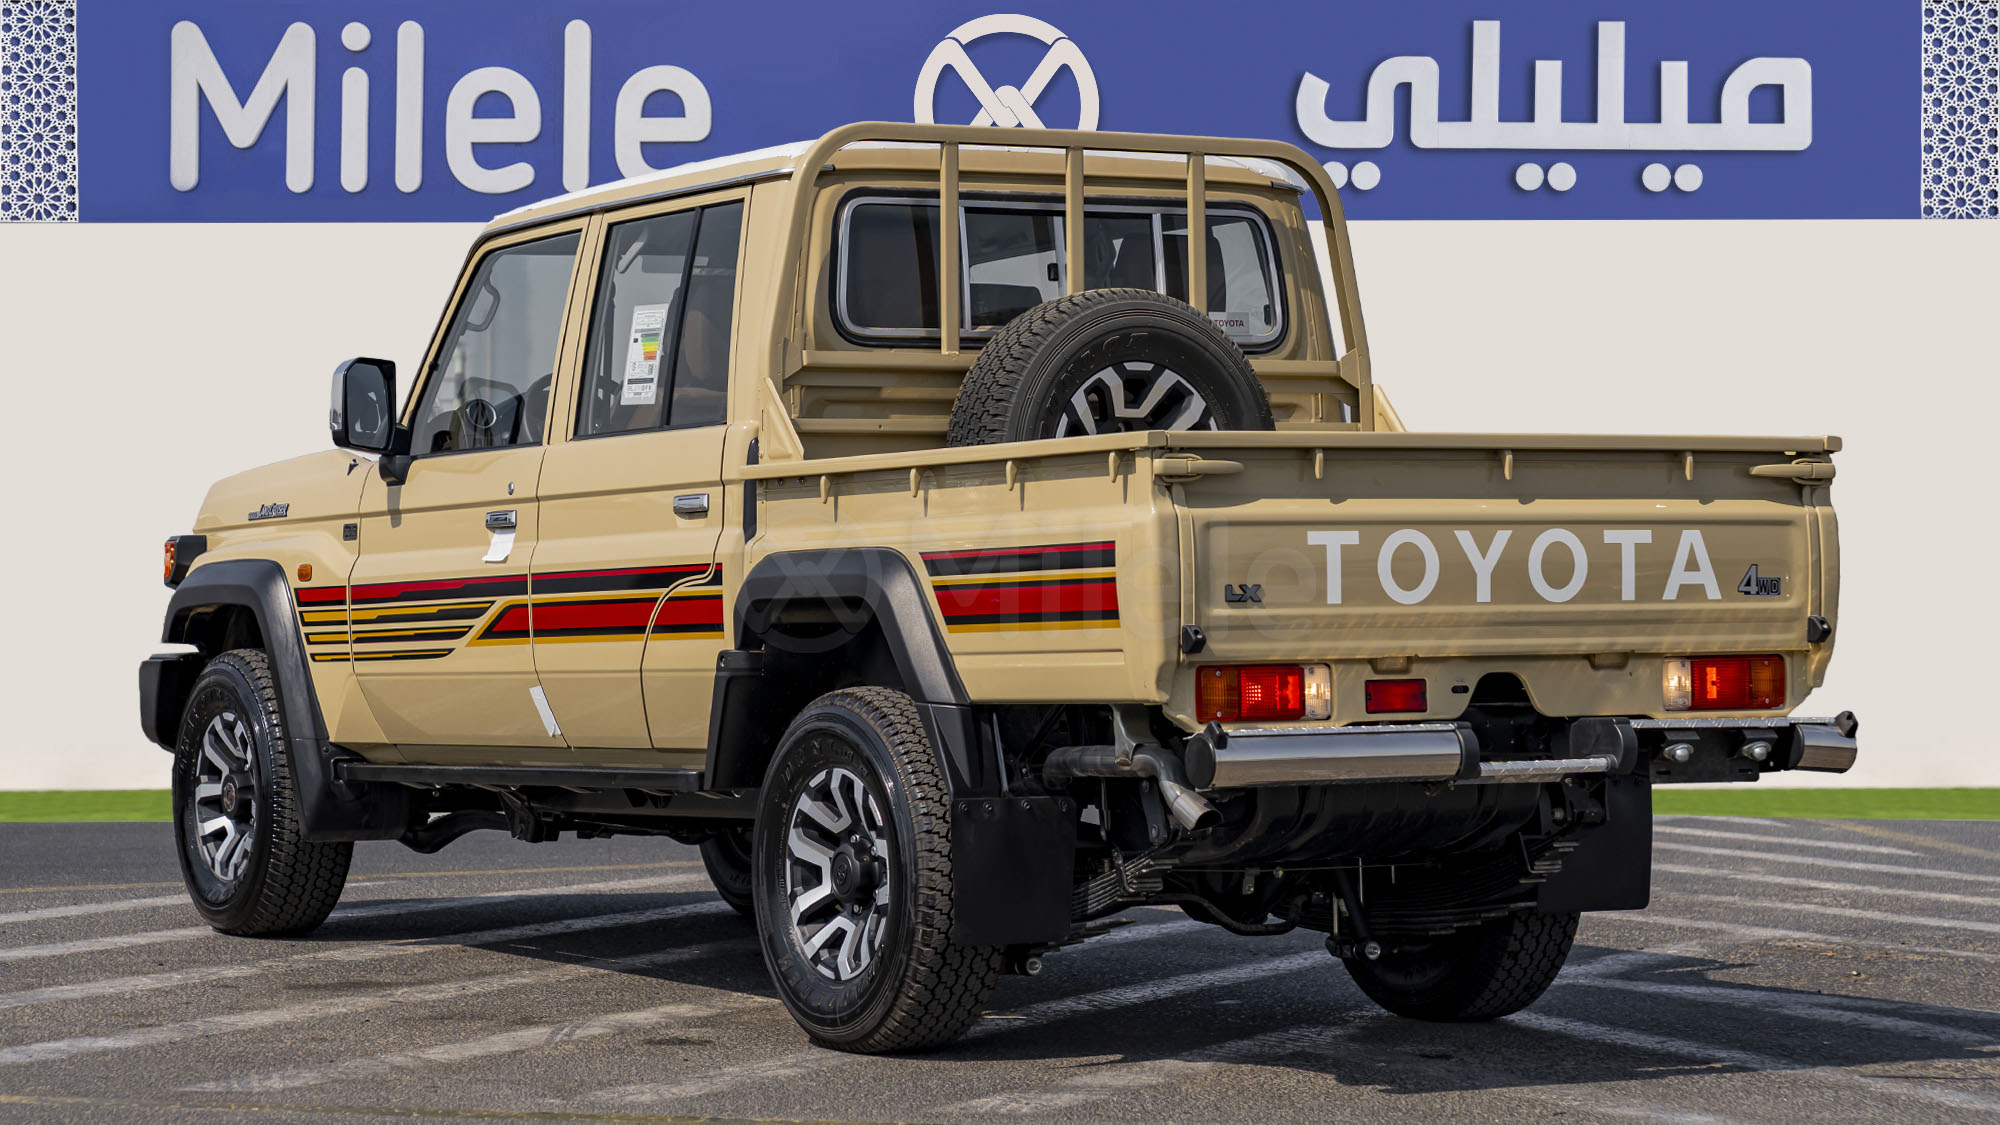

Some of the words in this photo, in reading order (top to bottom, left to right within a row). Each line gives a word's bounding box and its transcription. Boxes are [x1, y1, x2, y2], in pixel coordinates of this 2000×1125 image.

[170, 20, 712, 194] Milele
[1296, 20, 1813, 192] ميليلي
[1214, 319, 1245, 328] TOYOTA
[1224, 584, 1262, 602] LX
[1307, 528, 1723, 605] TOYOTA
[1737, 563, 1782, 596] 4WD
